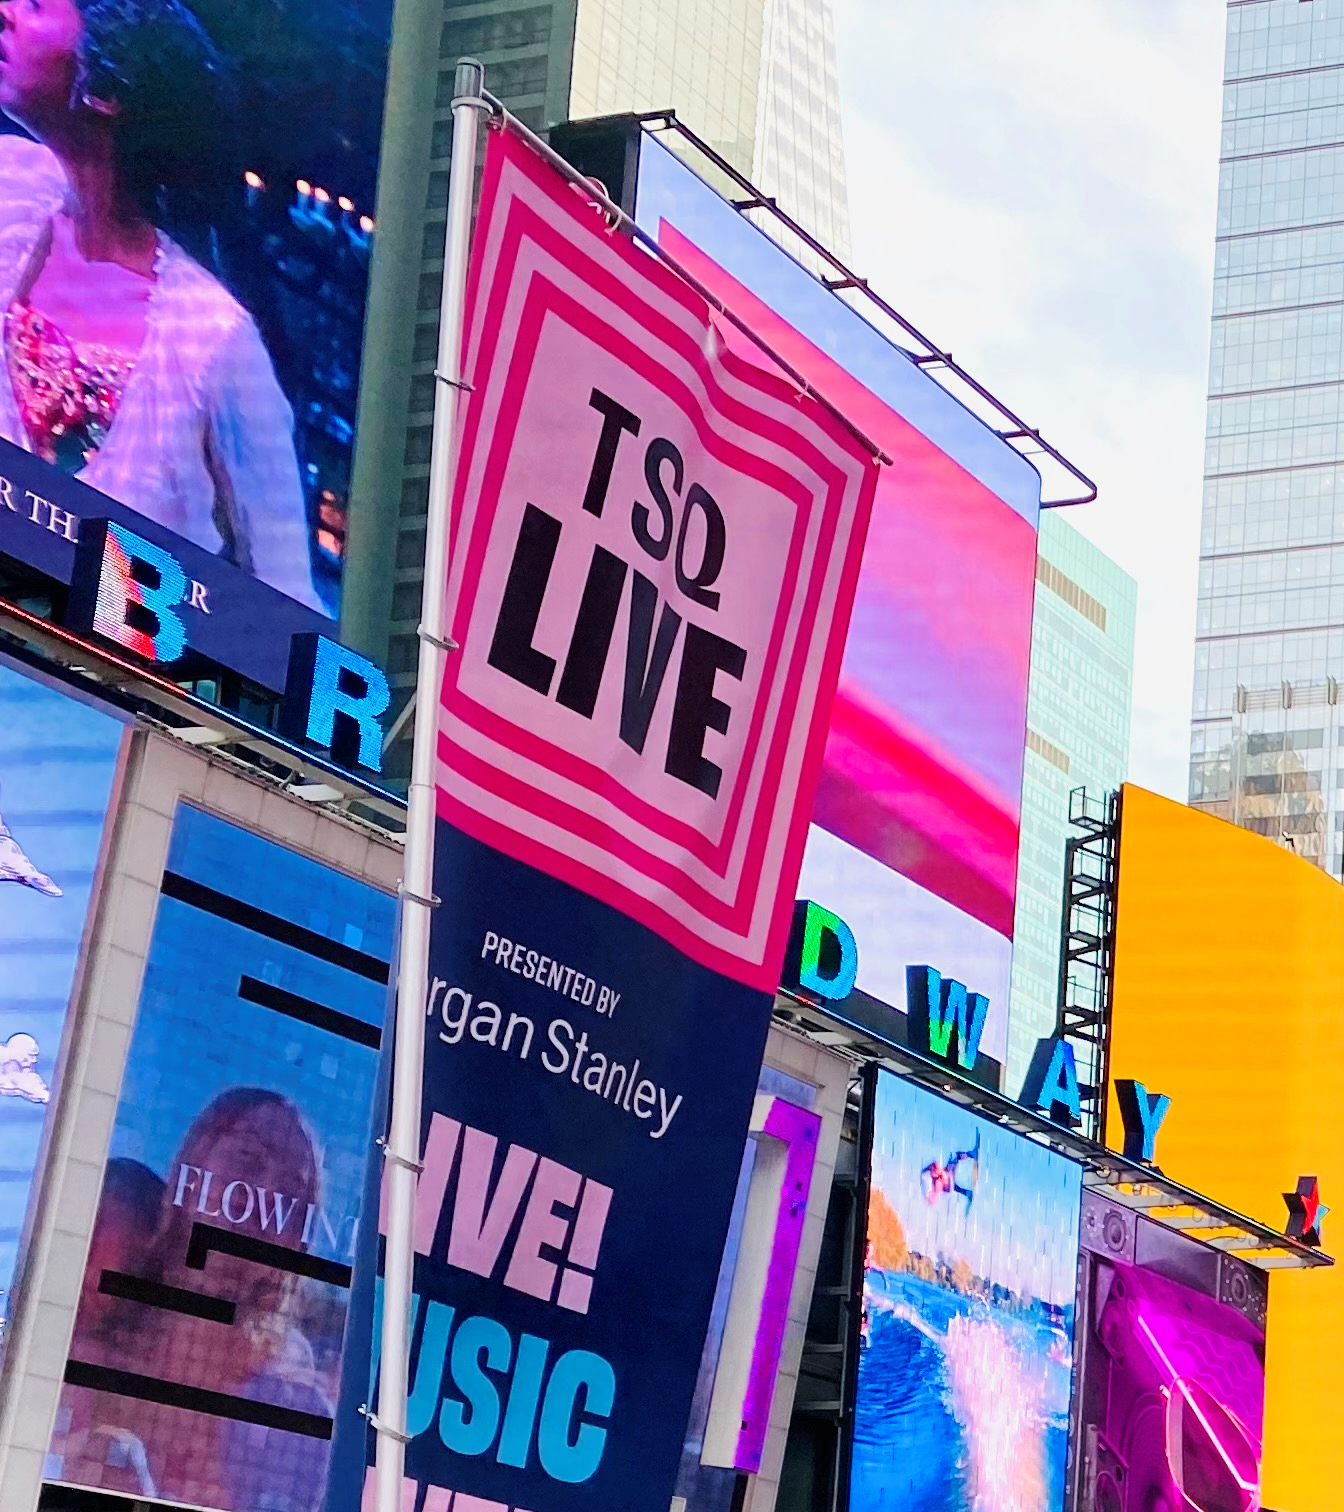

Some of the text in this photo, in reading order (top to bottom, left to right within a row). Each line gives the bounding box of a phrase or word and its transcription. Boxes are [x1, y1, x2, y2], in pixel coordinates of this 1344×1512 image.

[581, 386, 727, 612] TSQ
[486, 502, 748, 801] LIVE
[426, 975, 684, 1139] rgan Stanley
[480, 930, 621, 1019] PRESENTED BY
[171, 1162, 300, 1236] FLOW
[380, 1111, 614, 1315] IVE!
[372, 1277, 617, 1485] USIC
